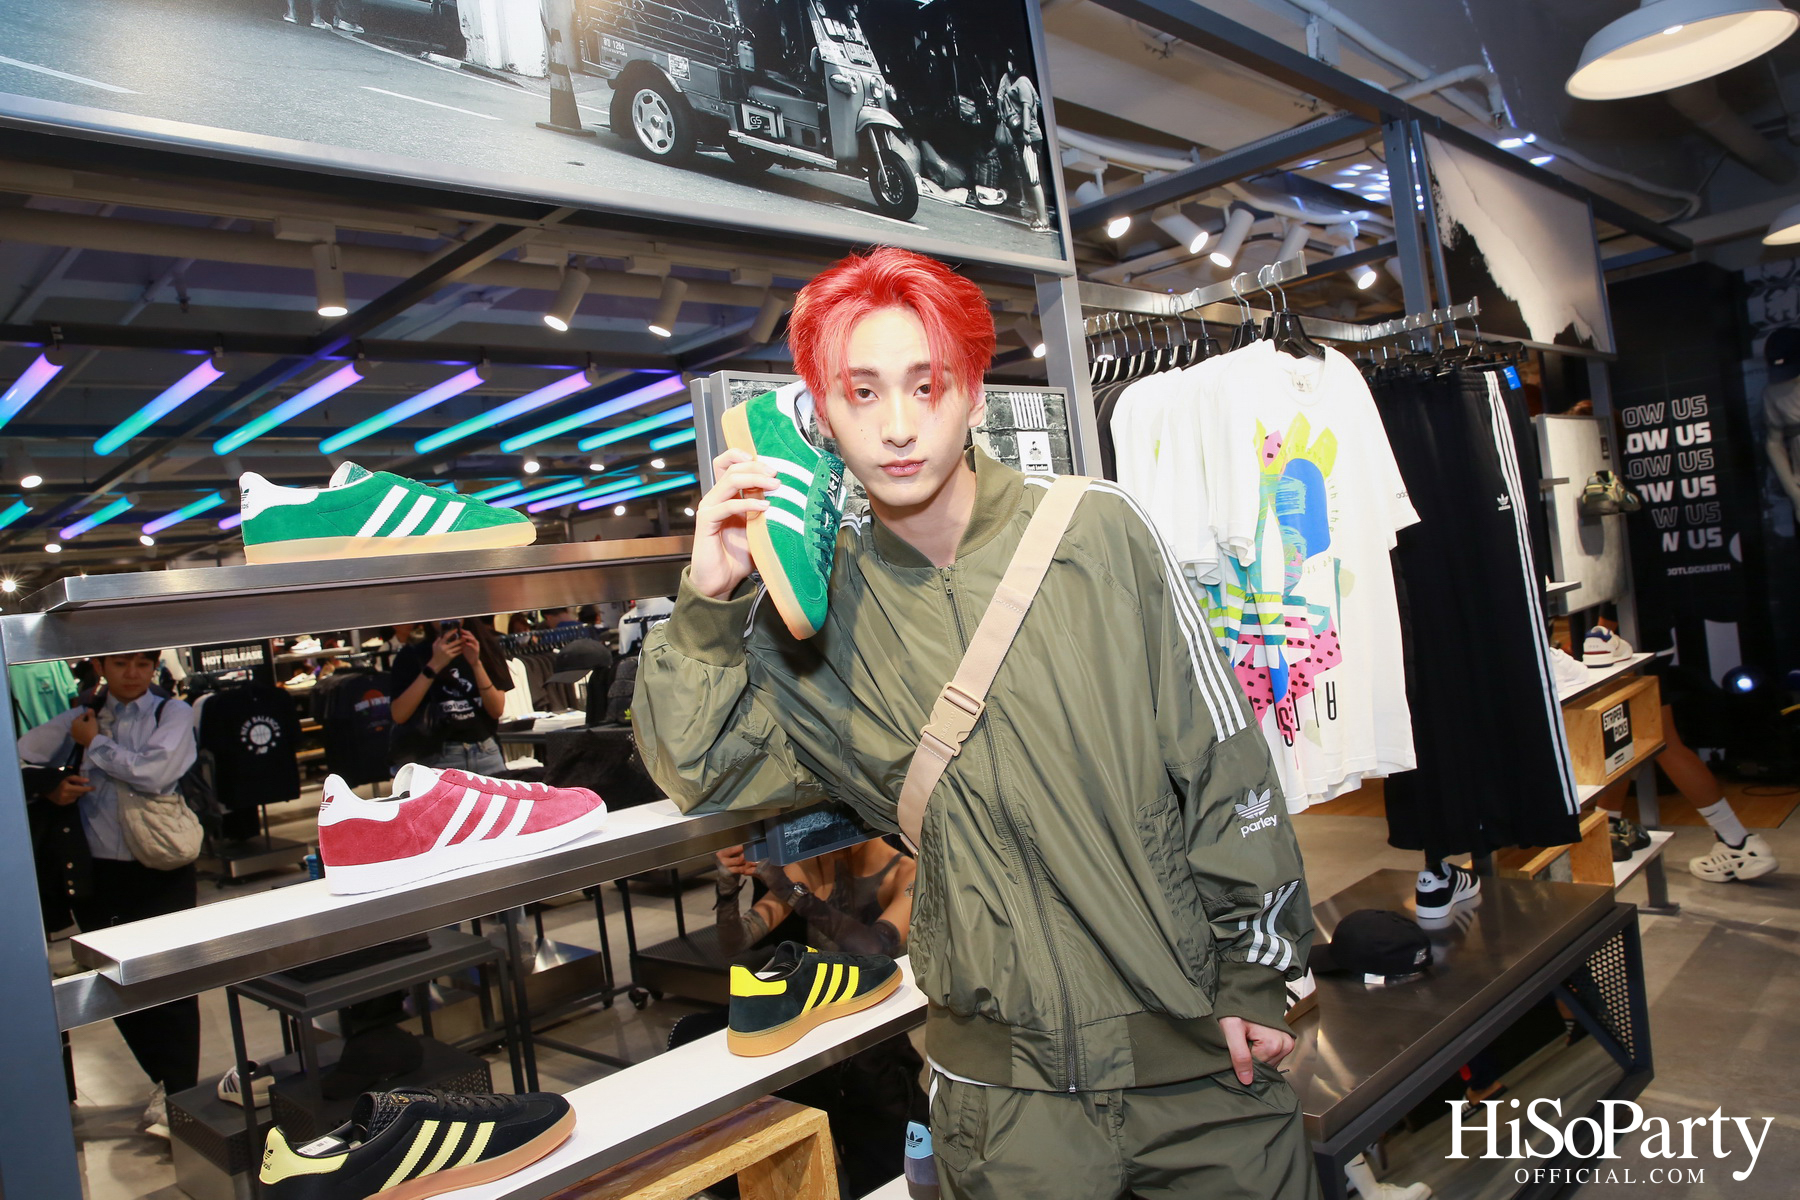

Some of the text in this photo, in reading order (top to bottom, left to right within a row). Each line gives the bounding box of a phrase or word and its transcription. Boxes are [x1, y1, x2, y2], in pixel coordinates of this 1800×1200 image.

[1671, 394, 1708, 420] US
[1624, 421, 1712, 454] OW US
[1625, 448, 1714, 479] OW US
[1681, 474, 1717, 499] US
[1685, 501, 1721, 525] US
[1687, 526, 1723, 550] US
[201, 650, 264, 667] HOT RELEASE
[1240, 814, 1277, 838] parley
